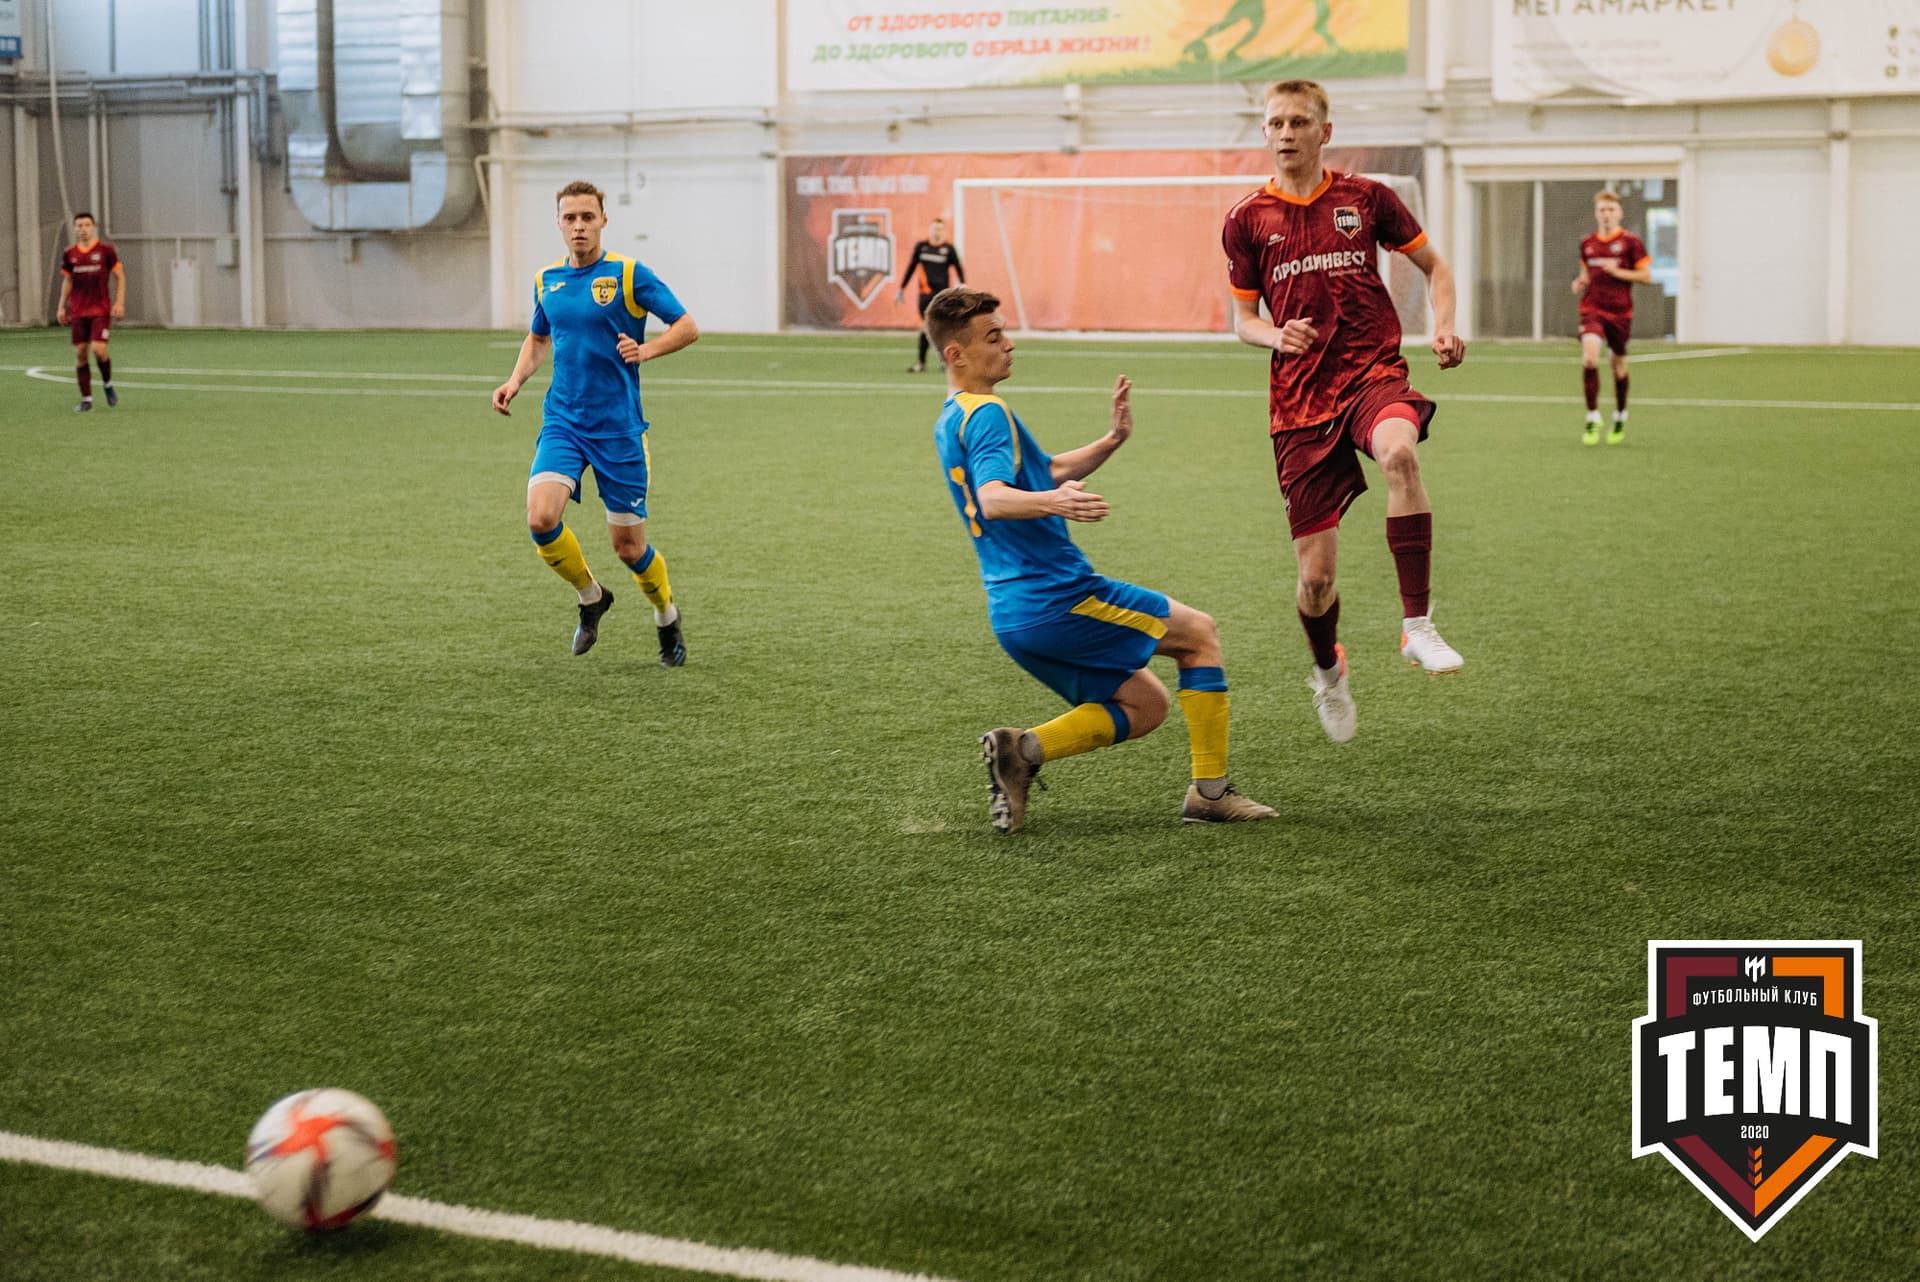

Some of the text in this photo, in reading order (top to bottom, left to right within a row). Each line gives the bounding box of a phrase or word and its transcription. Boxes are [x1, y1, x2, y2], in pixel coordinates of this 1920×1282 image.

[848, 15, 872, 32] ОТ
[878, 11, 1002, 32] ЗДОРОВОГО
[1007, 8, 1109, 27] ПИТАНИЯ
[811, 43, 840, 63] ДО
[845, 41, 968, 61] ЗДОРОВОГО
[972, 38, 1051, 57] ОБРАЗА
